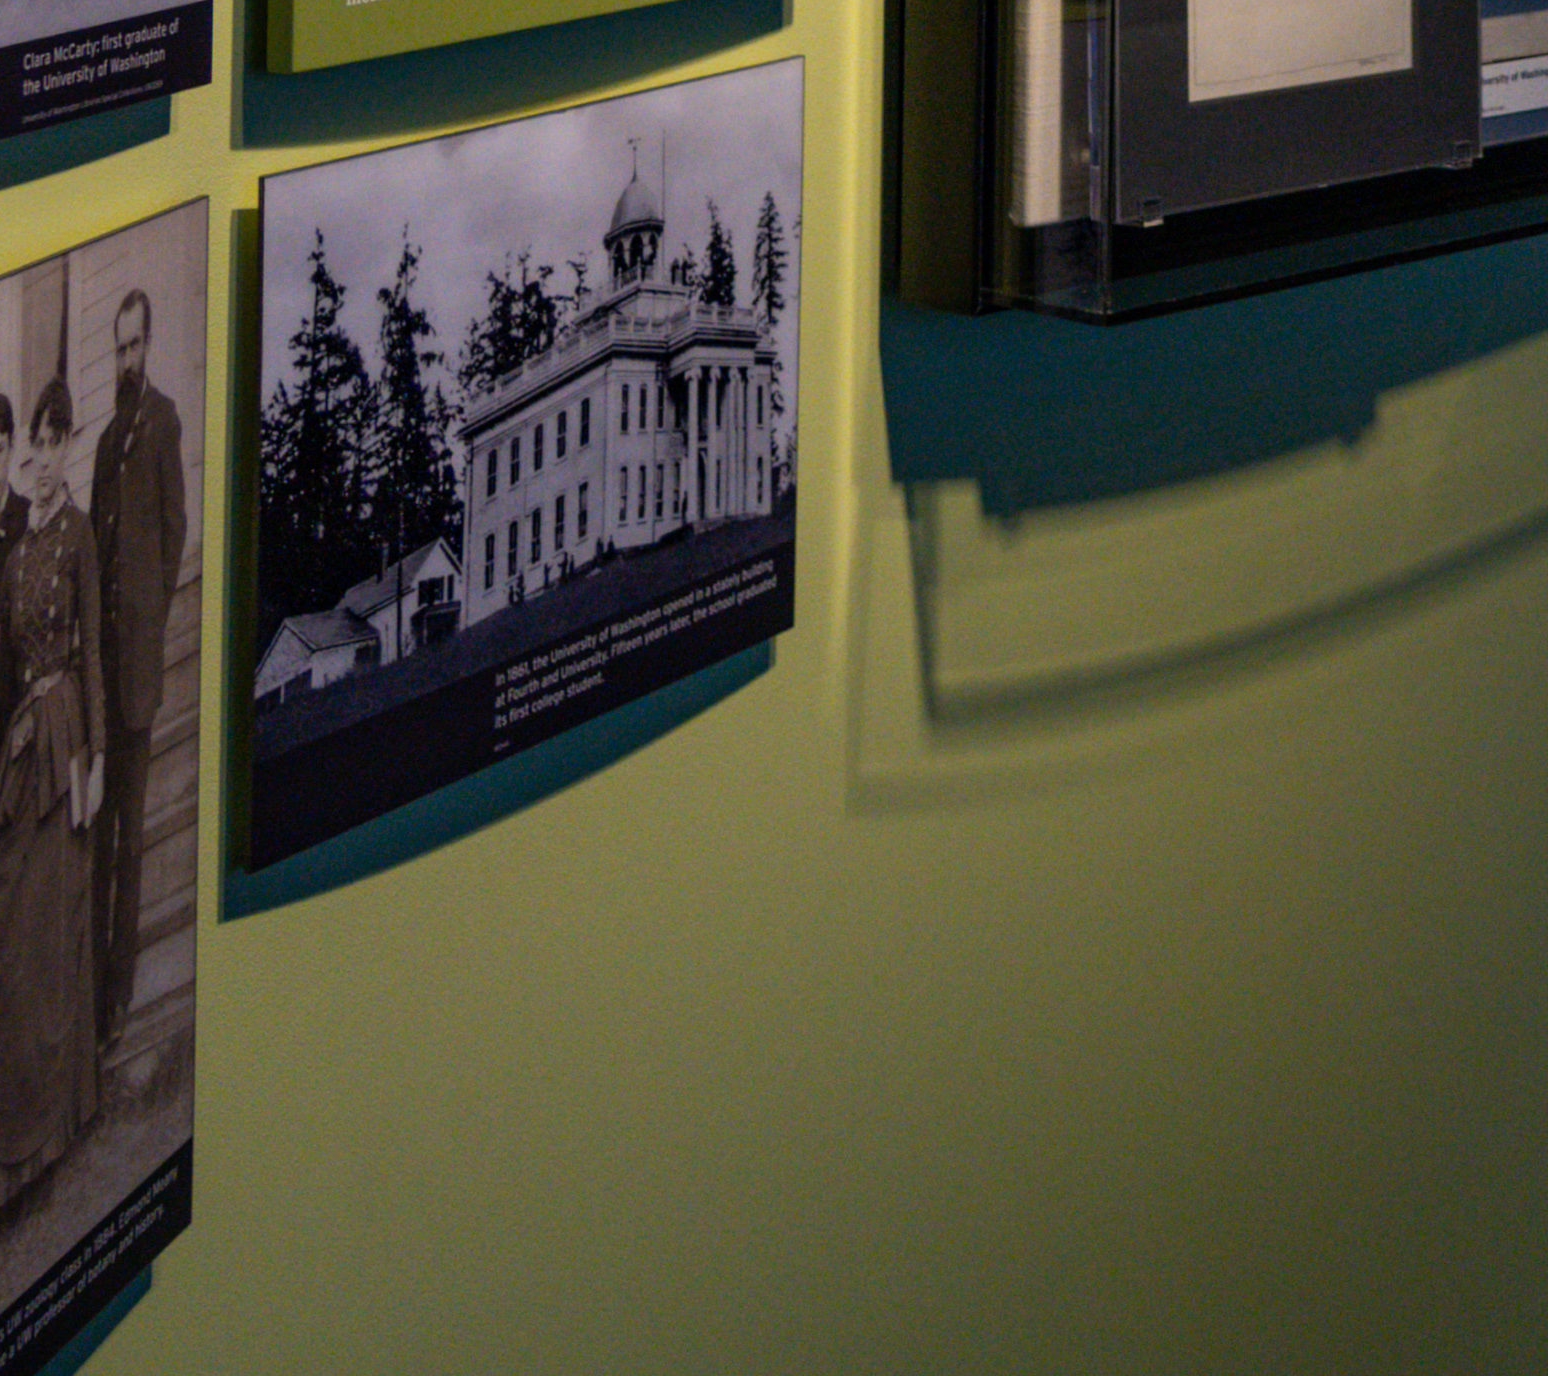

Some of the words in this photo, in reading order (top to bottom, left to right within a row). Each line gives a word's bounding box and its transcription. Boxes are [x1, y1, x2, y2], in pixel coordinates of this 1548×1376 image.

[23, 51, 51, 70] Clara
[54, 40, 100, 63] McCarty:
[102, 31, 123, 51] first
[125, 24, 167, 48] graduate
[169, 18, 180, 34] of
[22, 79, 41, 96] the
[44, 66, 96, 91] University
[97, 58, 109, 77] of
[111, 49, 166, 74] Washington
[532, 655, 549, 671] the
[551, 635, 597, 664] University
[599, 627, 609, 643] of
[541, 668, 559, 688] and
[509, 704, 530, 723] first
